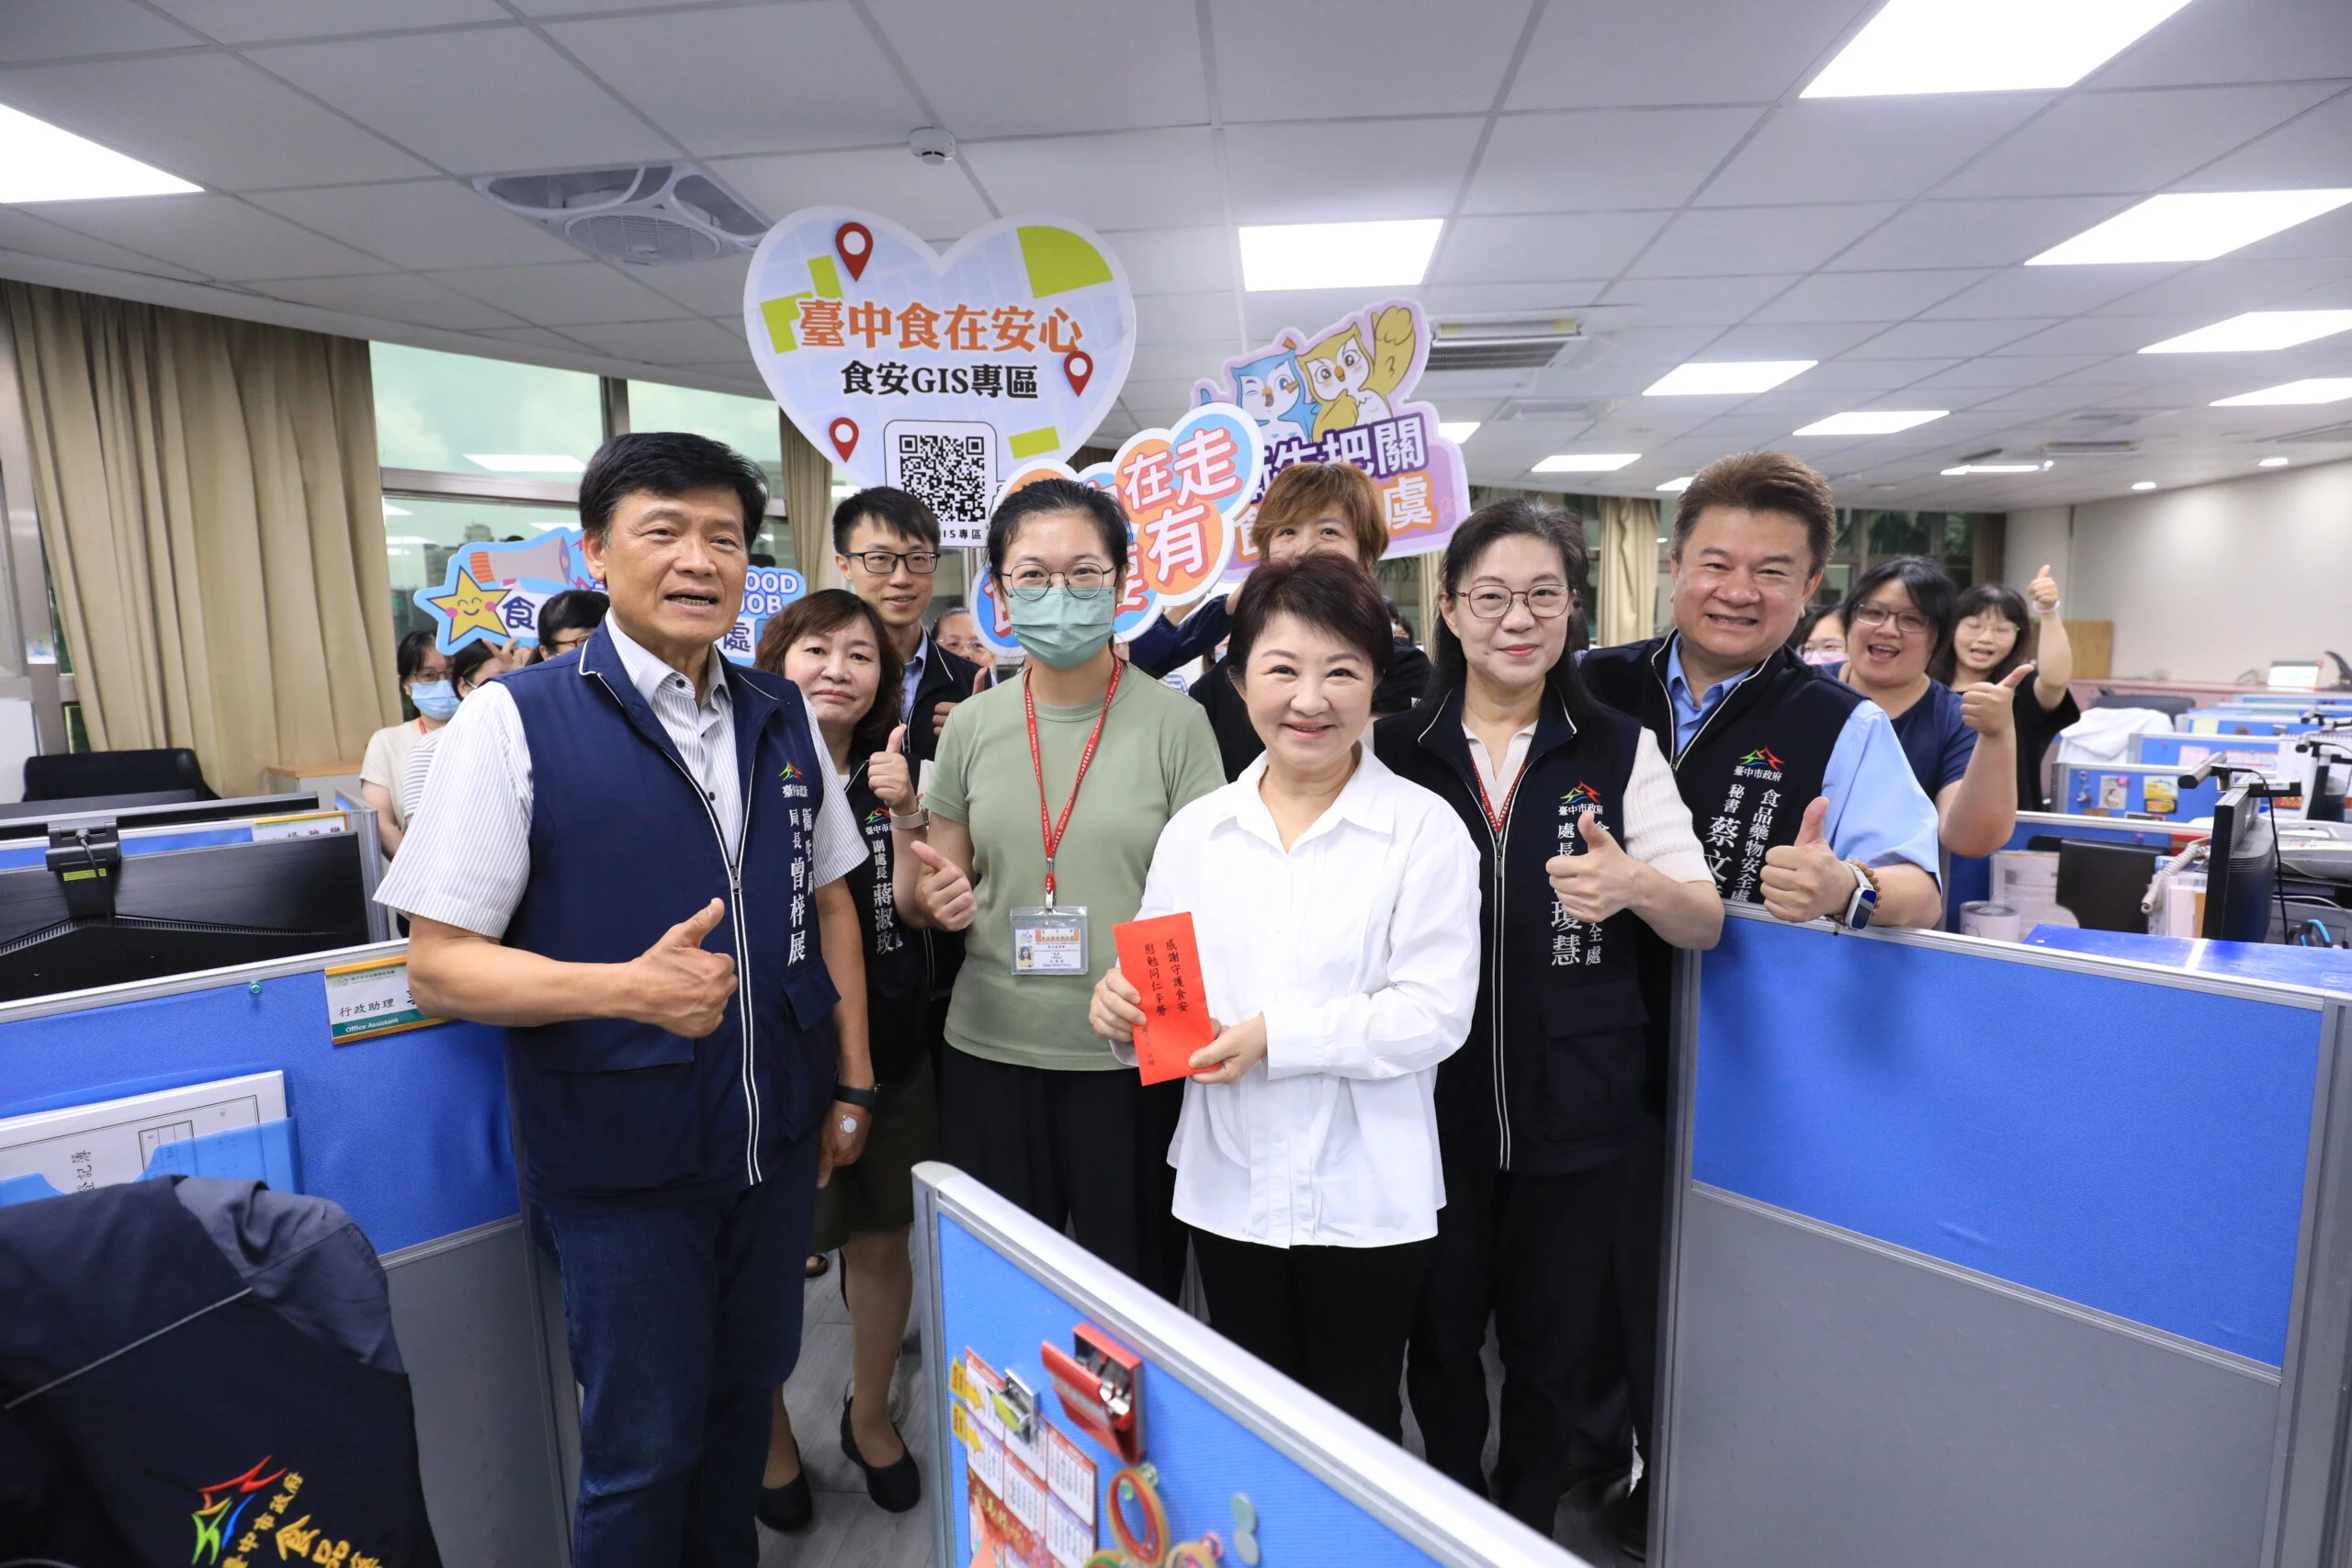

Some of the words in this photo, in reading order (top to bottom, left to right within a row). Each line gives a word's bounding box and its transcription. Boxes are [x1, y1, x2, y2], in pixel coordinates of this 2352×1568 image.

[798, 299, 1083, 353] 臺中食在安心
[842, 359, 1038, 399] 食安GIS專區
[741, 593, 783, 615] OB
[1734, 765, 1783, 782] 臺中市政府
[865, 823, 892, 835] 臺中市
[1166, 939, 1189, 1012] 感謝守護食安
[339, 998, 395, 1018] 行政助理
[345, 1024, 367, 1032] Office
[368, 1017, 399, 1029] Assistant
